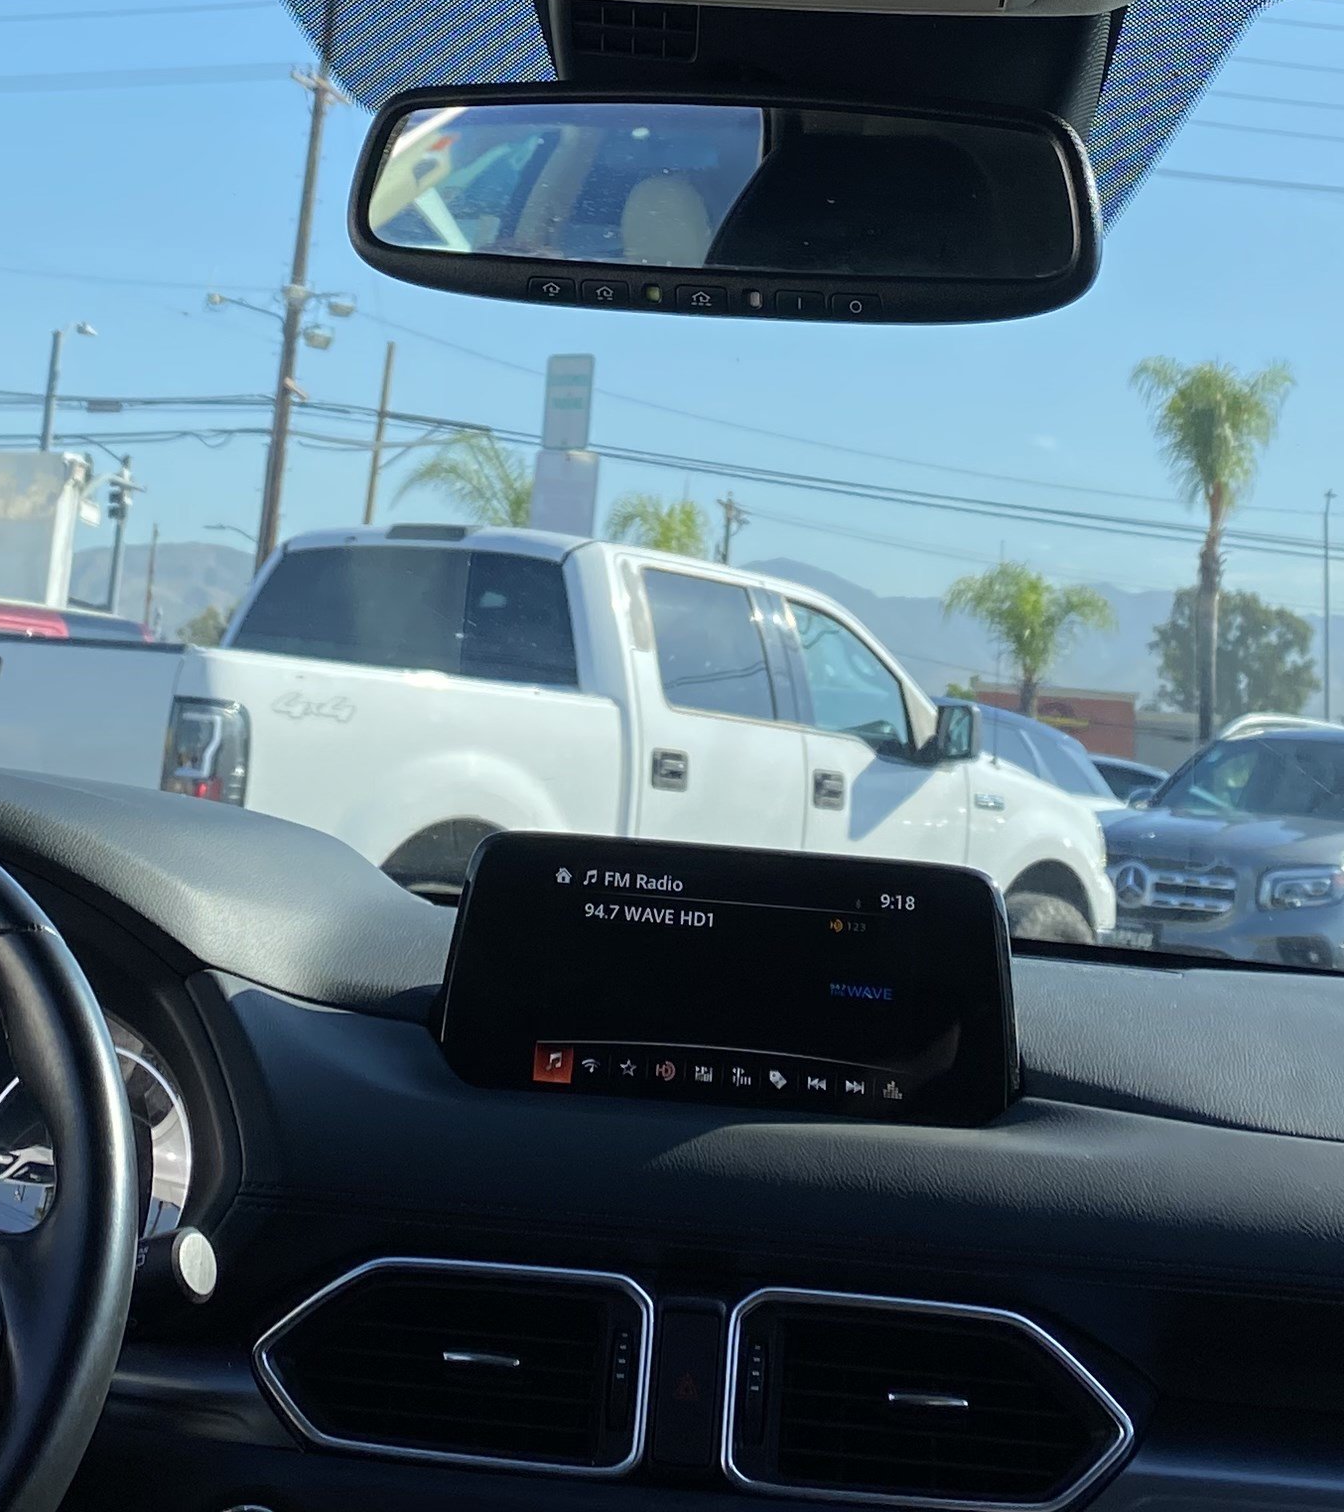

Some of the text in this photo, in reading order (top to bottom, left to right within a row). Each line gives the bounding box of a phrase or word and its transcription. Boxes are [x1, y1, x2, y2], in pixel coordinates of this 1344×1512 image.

[270, 689, 358, 724] 4x4
[604, 871, 683, 892] FM Radio
[881, 894, 915, 912] 9:18
[585, 903, 714, 928] 94.7 WAVE HD1
[846, 986, 893, 1001] WAVE
